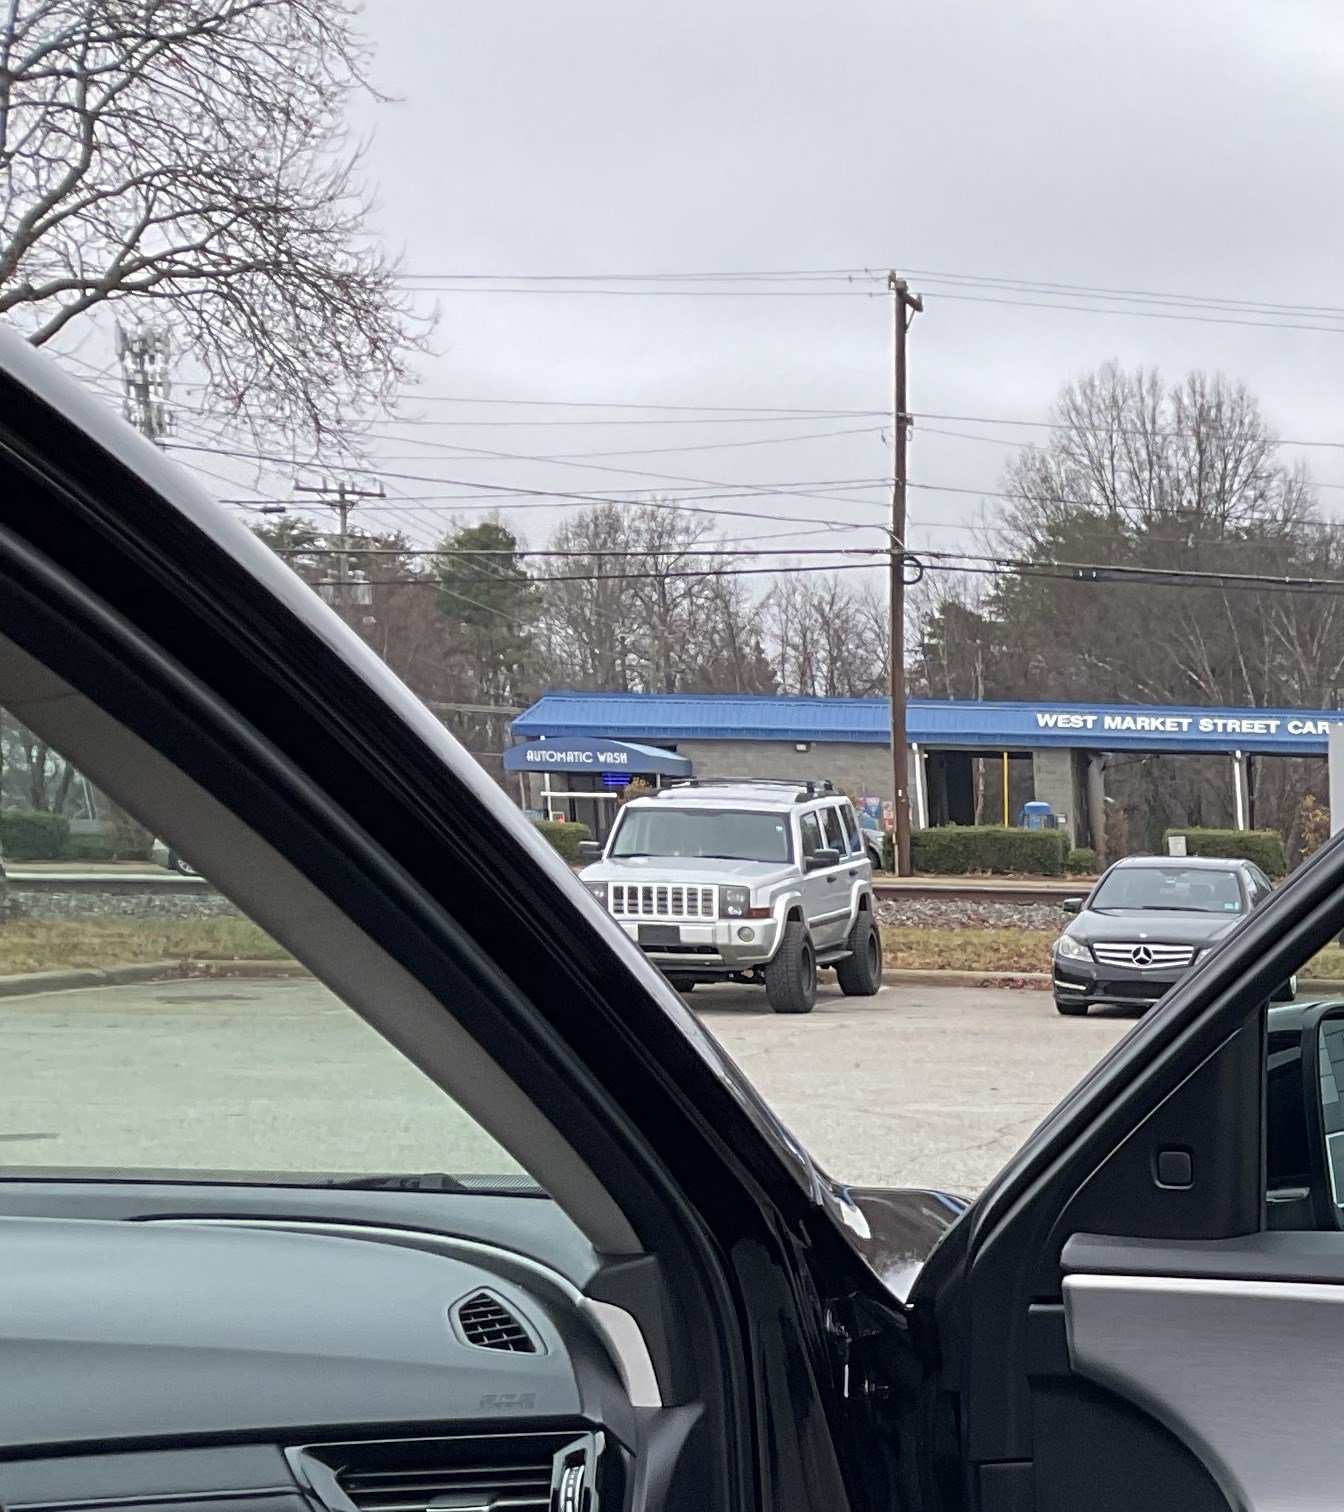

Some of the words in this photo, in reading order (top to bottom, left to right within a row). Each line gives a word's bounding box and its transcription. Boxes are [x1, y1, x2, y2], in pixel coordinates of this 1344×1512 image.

[1036, 713, 1098, 730] WEST
[1103, 715, 1193, 732] MARKET
[1198, 717, 1280, 735] STREET
[1287, 719, 1330, 735] CAR
[526, 750, 593, 763] AUTOMATIC
[597, 752, 628, 764] WASH
